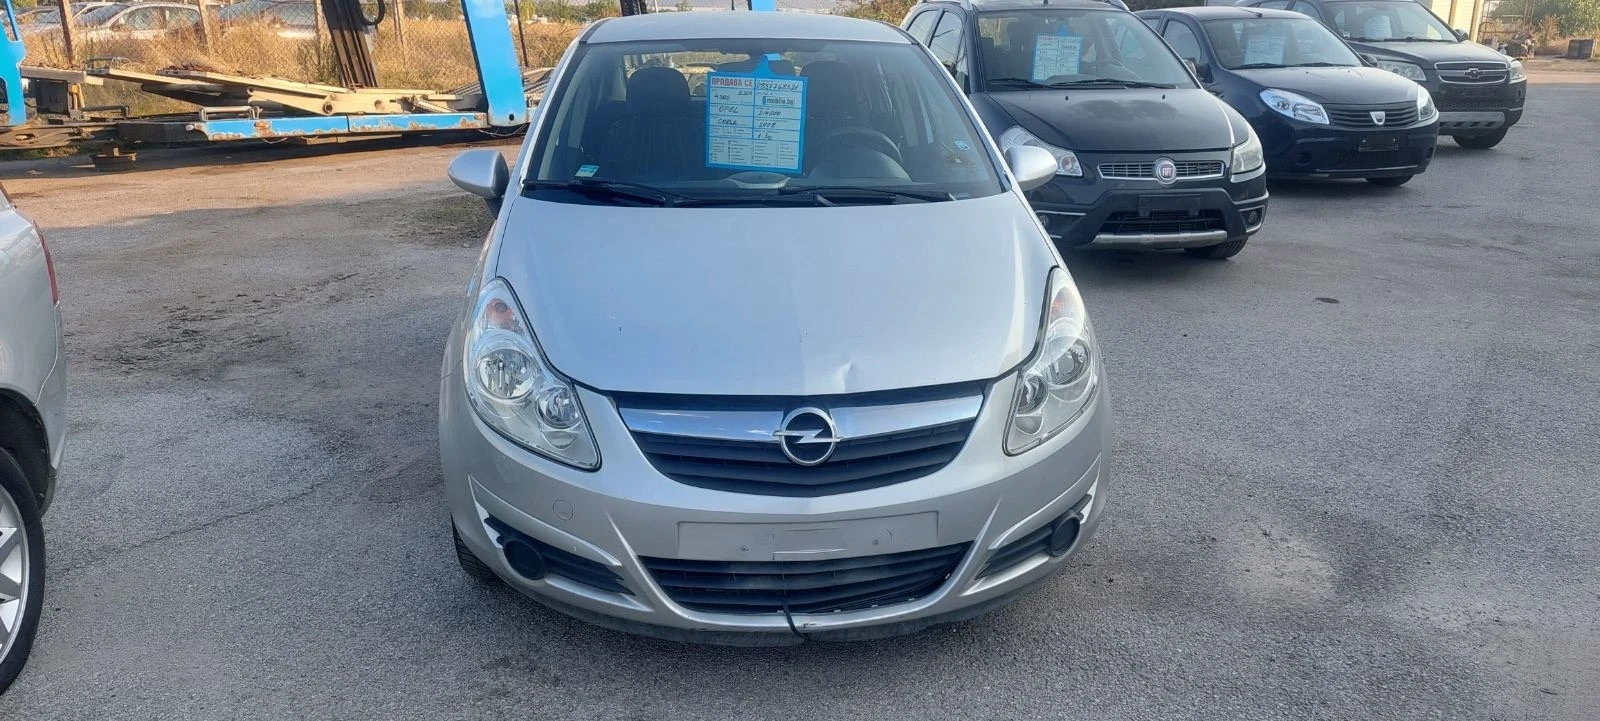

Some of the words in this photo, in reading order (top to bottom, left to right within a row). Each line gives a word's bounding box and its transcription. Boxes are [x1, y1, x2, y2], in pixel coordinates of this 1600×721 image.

[711, 77, 742, 87] ПРОДАВА
[744, 78, 753, 87] СЕ
[766, 97, 795, 105] mobile.bg
[719, 105, 739, 113] OPEL
